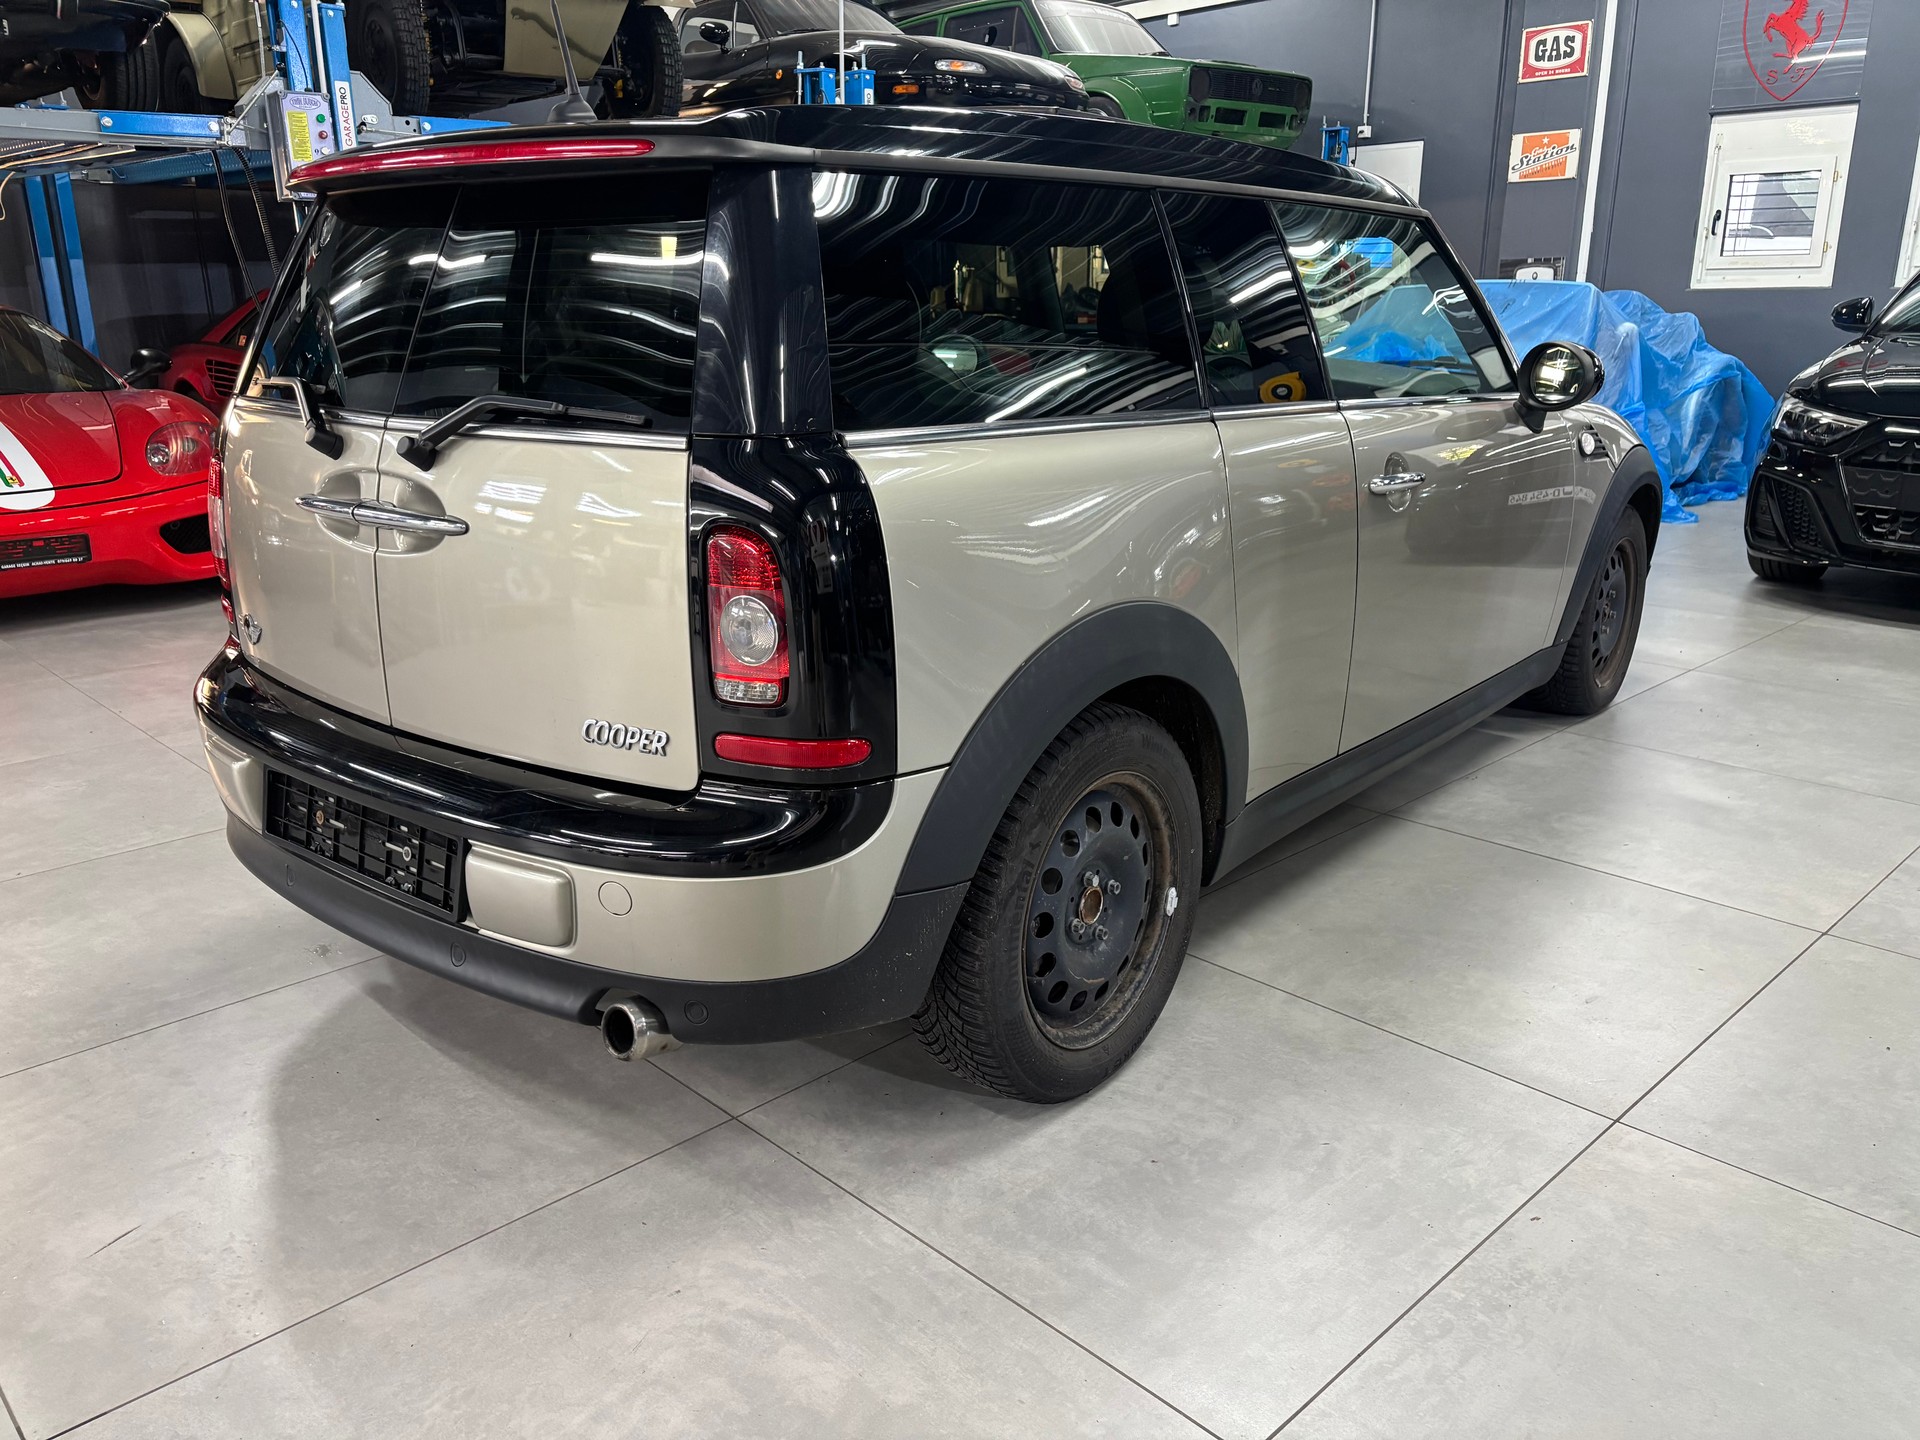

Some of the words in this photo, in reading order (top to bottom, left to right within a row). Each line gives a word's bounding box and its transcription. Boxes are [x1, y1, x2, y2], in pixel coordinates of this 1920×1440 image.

[1534, 34, 1576, 63] GAS
[1766, 69, 1778, 85] S
[1790, 67, 1812, 84] F
[339, 86, 354, 148] GARAGEPRO
[1511, 143, 1577, 172] Station
[582, 718, 669, 757] COOPER
